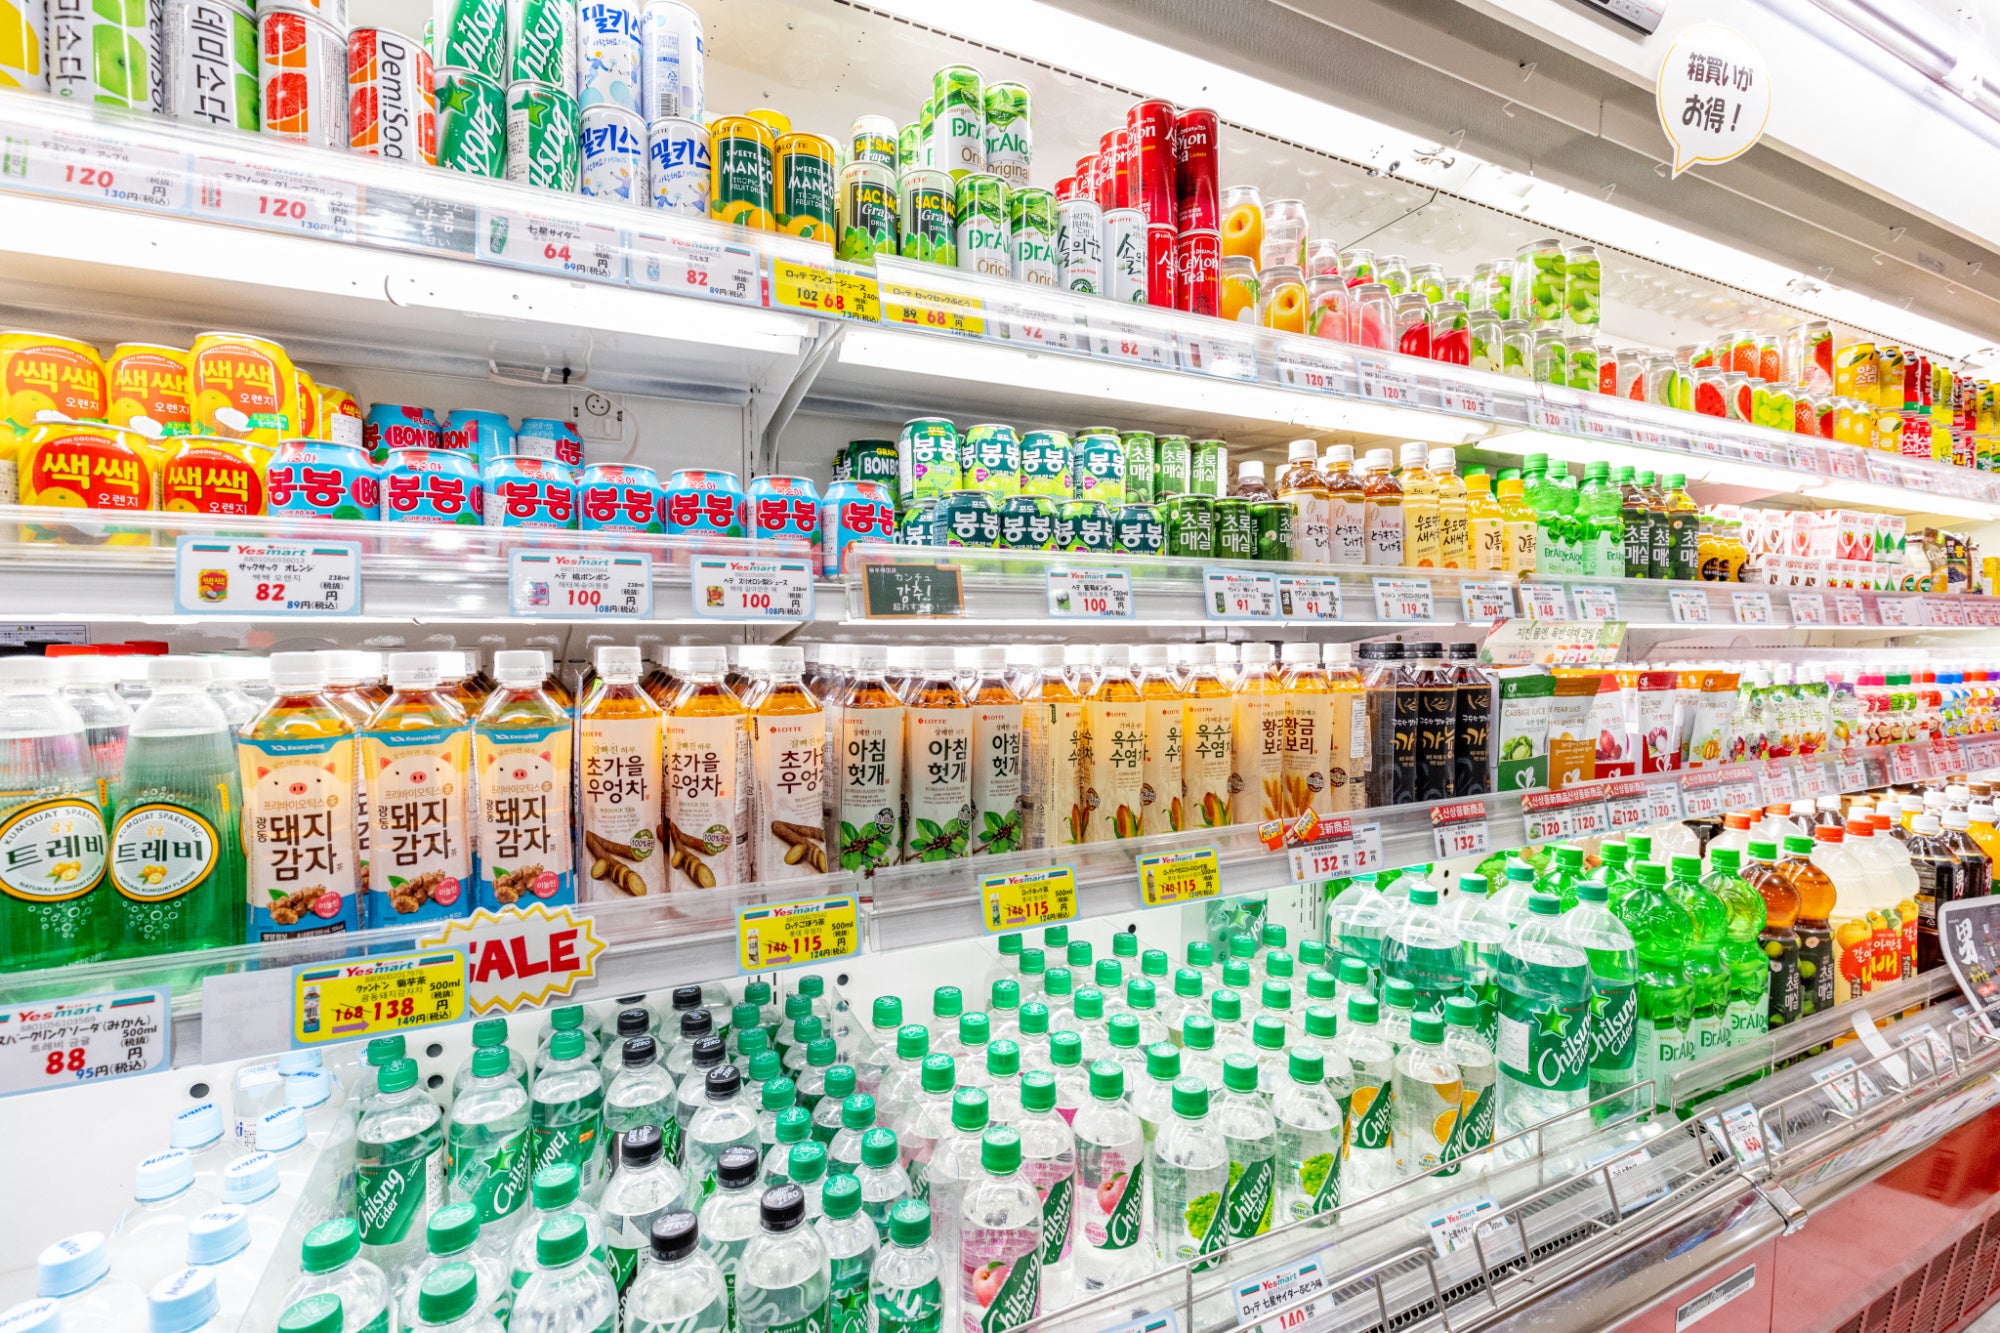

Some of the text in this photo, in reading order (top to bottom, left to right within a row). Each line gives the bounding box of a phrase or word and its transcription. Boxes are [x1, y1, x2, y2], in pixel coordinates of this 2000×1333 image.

[580, 123, 641, 158] 밀키스
[64, 164, 114, 189] 120
[722, 161, 774, 186] MANGO
[788, 176, 835, 201] MANGO
[856, 188, 882, 204] SAC
[258, 195, 307, 220] 120
[915, 195, 940, 210] SAC
[861, 203, 895, 223] Grape
[919, 209, 954, 229] Grape
[543, 243, 571, 263] 64
[686, 269, 709, 287] 82
[797, 287, 819, 302] 102
[823, 293, 845, 311] 68
[902, 308, 918, 319] 89
[926, 309, 946, 325] 68
[1305, 372, 1324, 387] 120
[239, 392, 275, 407] 오렌지
[1382, 386, 1400, 400] 120
[65, 396, 100, 412] 오렌지
[1461, 399, 1477, 412] 120
[1544, 412, 1561, 426] 120
[913, 434, 957, 464] 봉봉
[1193, 455, 1217, 472] 초록
[1193, 467, 1217, 483] 매실
[266, 466, 347, 508] 봉봉
[387, 474, 467, 515] 봉봉
[97, 492, 139, 508] 오렌지
[208, 501, 248, 515] 오렌지
[505, 481, 576, 523] 봉봉
[587, 486, 655, 525] 봉봉
[671, 492, 736, 528] 봉봉
[759, 498, 818, 533] 봉봉
[952, 510, 999, 540] 봉봉
[1002, 514, 1051, 543] 봉봉
[1179, 510, 1212, 533] 초록
[1119, 522, 1164, 549] 봉봉
[1179, 530, 1212, 552] 매실
[236, 544, 307, 558] Yesmart
[284, 563, 315, 573] オレンジ
[554, 555, 610, 567] Yesmart
[729, 561, 777, 573] Yesmart
[1070, 571, 1105, 580] Yesmart
[255, 583, 286, 601] 82
[567, 589, 602, 607] 100
[741, 593, 771, 609] 100
[1083, 597, 1107, 612] 100
[1236, 598, 1249, 612] 91
[1306, 601, 1319, 614] 91
[1401, 603, 1417, 615] 119
[1284, 717, 1316, 737] 황금
[848, 738, 886, 764] 아침
[928, 737, 968, 763] 아침
[1284, 737, 1315, 755] 보리
[586, 754, 645, 779] 초가을
[671, 751, 721, 774] 초가을
[847, 763, 885, 787] 헛개
[927, 761, 967, 785] 헛개
[586, 777, 648, 804] 우엉차
[671, 776, 723, 799] 우엉차
[494, 794, 547, 827] 돼지
[1652, 803, 1670, 818] 120
[1696, 798, 1713, 812] 120
[390, 798, 448, 833] 돼지
[1577, 815, 1596, 830] 120
[1621, 808, 1640, 824] 120
[270, 809, 333, 848] 돼지
[1540, 822, 1560, 837] 120
[391, 829, 452, 867] 감자
[495, 824, 551, 859] 감자
[1453, 834, 1475, 851] 132
[5, 834, 105, 873] 트레비
[116, 839, 204, 863] 트레비
[1161, 853, 1193, 865] Yesmart
[270, 844, 337, 882] 감자
[1312, 854, 1339, 874] 132
[1007, 873, 1046, 886] Yesmart
[1176, 879, 1197, 894] 115
[773, 904, 821, 918] Yesmart
[1025, 901, 1049, 918] 115
[831, 921, 854, 931] 500ml
[793, 935, 822, 955] 115
[469, 928, 581, 985] ALE
[345, 961, 414, 978] Yesmart
[429, 978, 461, 991] 500ml
[18, 1002, 104, 1023] Yesmart
[334, 1003, 364, 1023] 168
[373, 996, 415, 1022] 138
[121, 1025, 158, 1038] 500ml
[44, 1046, 87, 1076] 88
[358, 1166, 406, 1240] Chilsung
[375, 1192, 399, 1231] Cider
[1446, 1208, 1476, 1224] Yesmart
[1261, 1272, 1298, 1291] Yesmart
[1242, 1301, 1262, 1316] ロッテ
